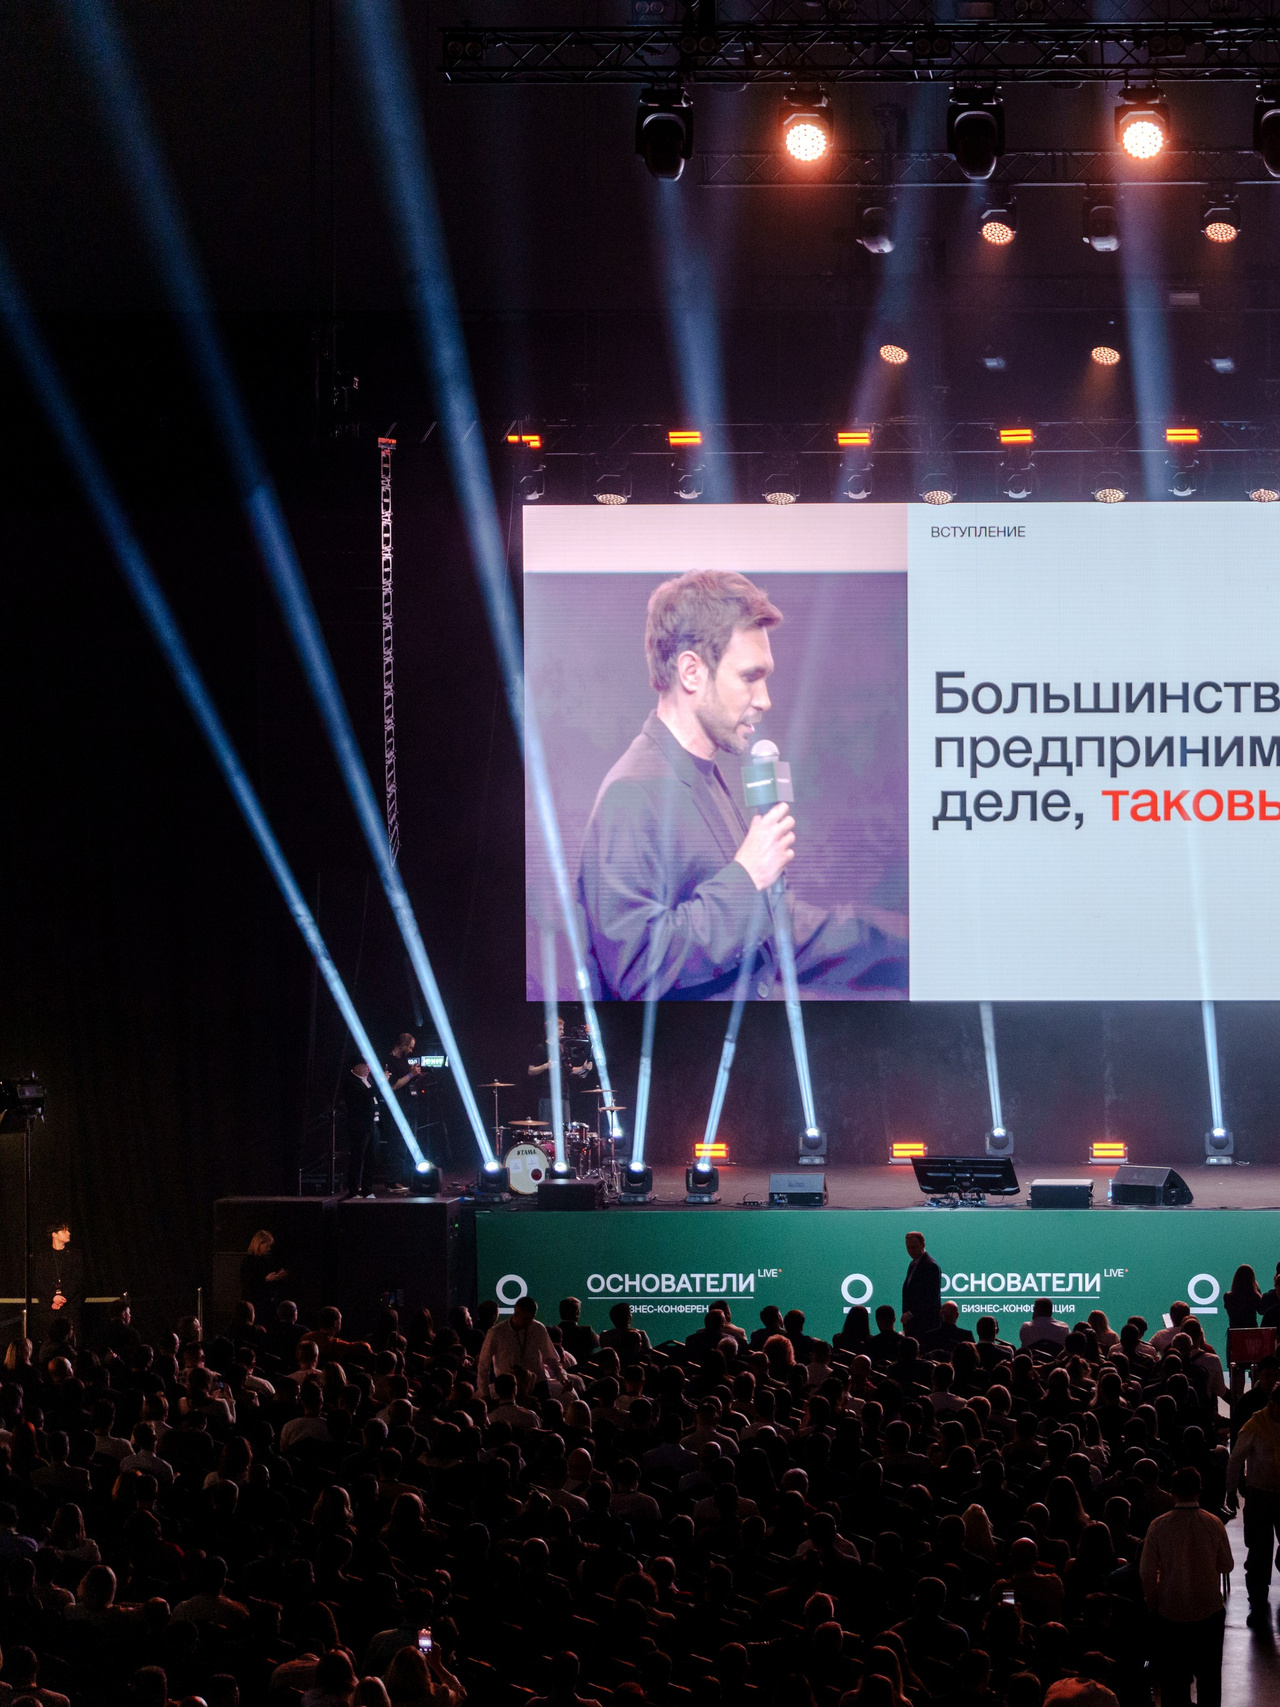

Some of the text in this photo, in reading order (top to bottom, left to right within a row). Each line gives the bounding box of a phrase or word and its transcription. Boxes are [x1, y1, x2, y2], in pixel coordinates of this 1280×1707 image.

[931, 526, 1026, 538] ВСТУПЛЕНИЕ
[932, 789, 1084, 831] деле,
[1104, 1268, 1124, 1277] LIVE
[587, 1269, 778, 1293] ОСНОВАТЕЛИ LIVE
[629, 1304, 709, 1314] ЗНЕС-КОНФЕРЕН
